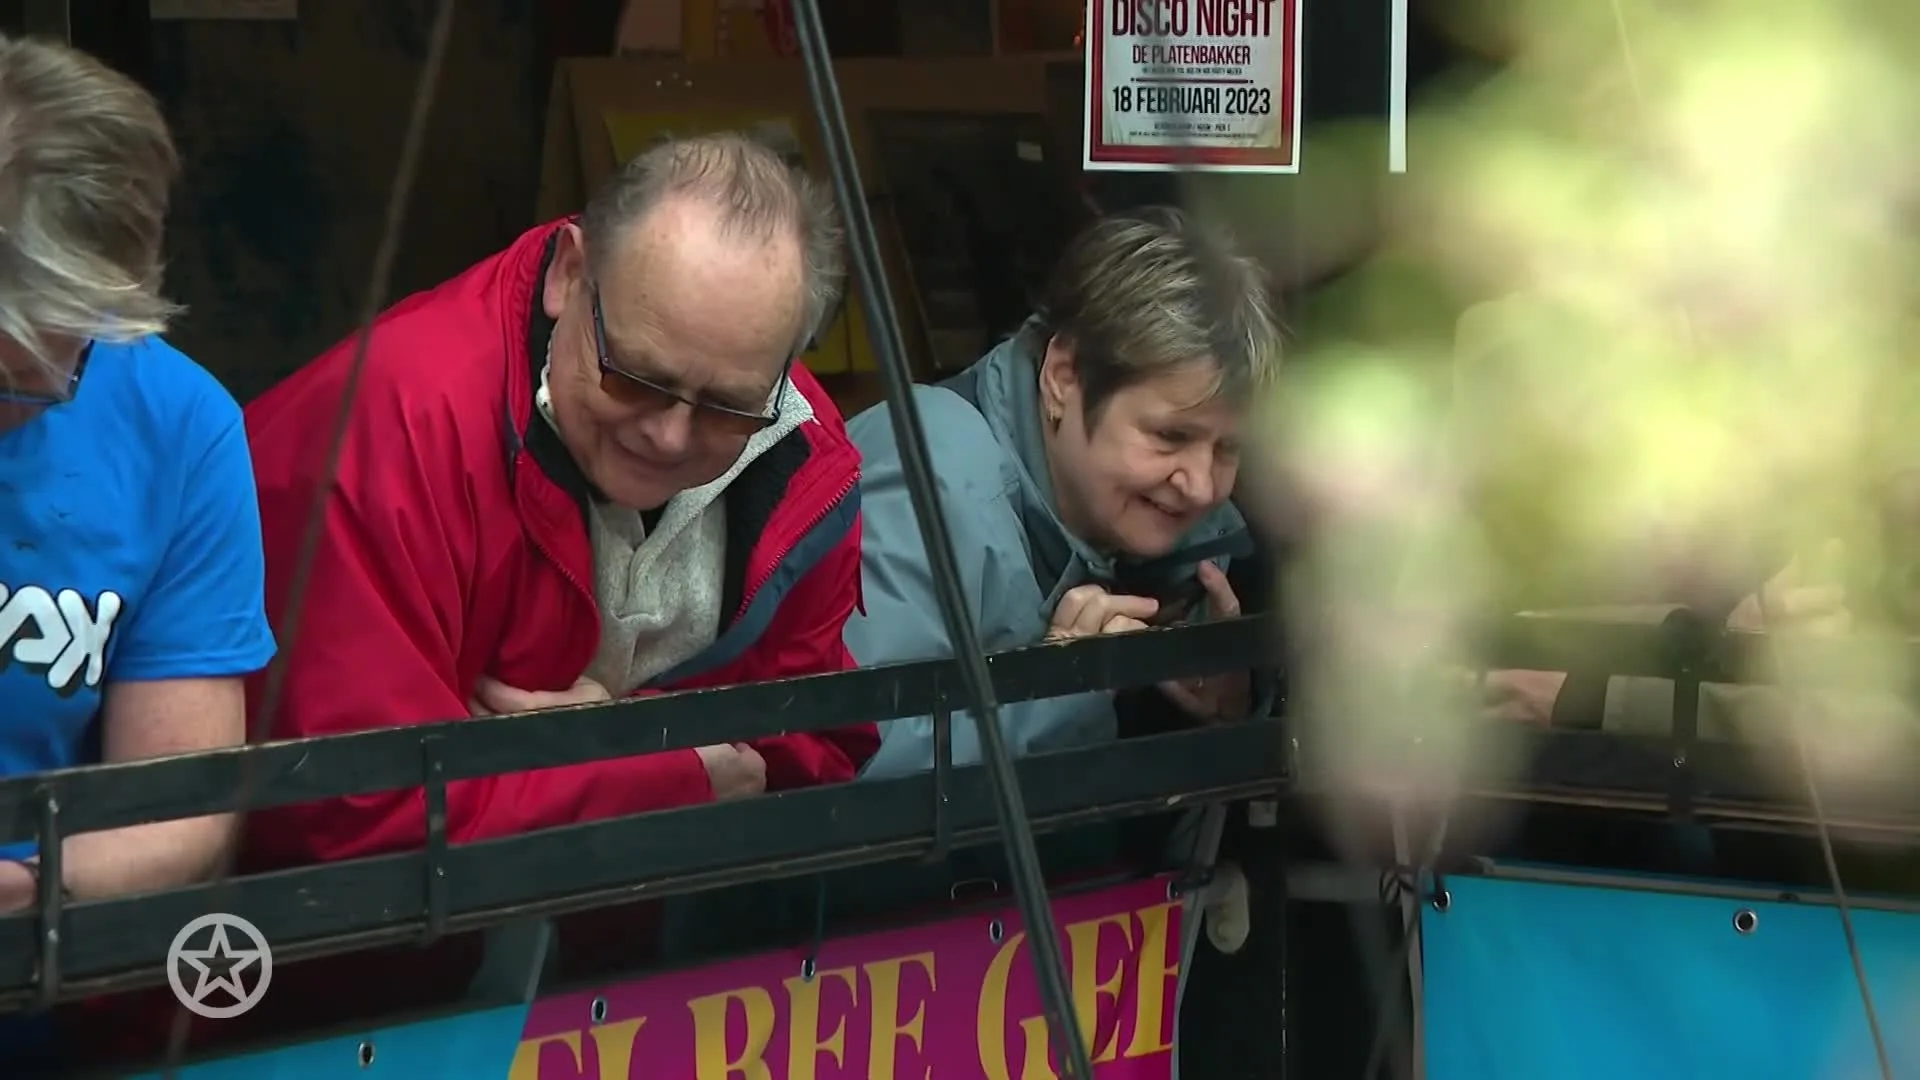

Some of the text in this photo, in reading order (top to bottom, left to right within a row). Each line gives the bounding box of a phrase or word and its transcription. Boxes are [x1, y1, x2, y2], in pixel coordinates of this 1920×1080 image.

[1112, 0, 1275, 37] DISCO NIGHT
[1132, 44, 1251, 65] DE PLATENBAKKER
[1112, 86, 1271, 115] 18 FEBRUARI 2023
